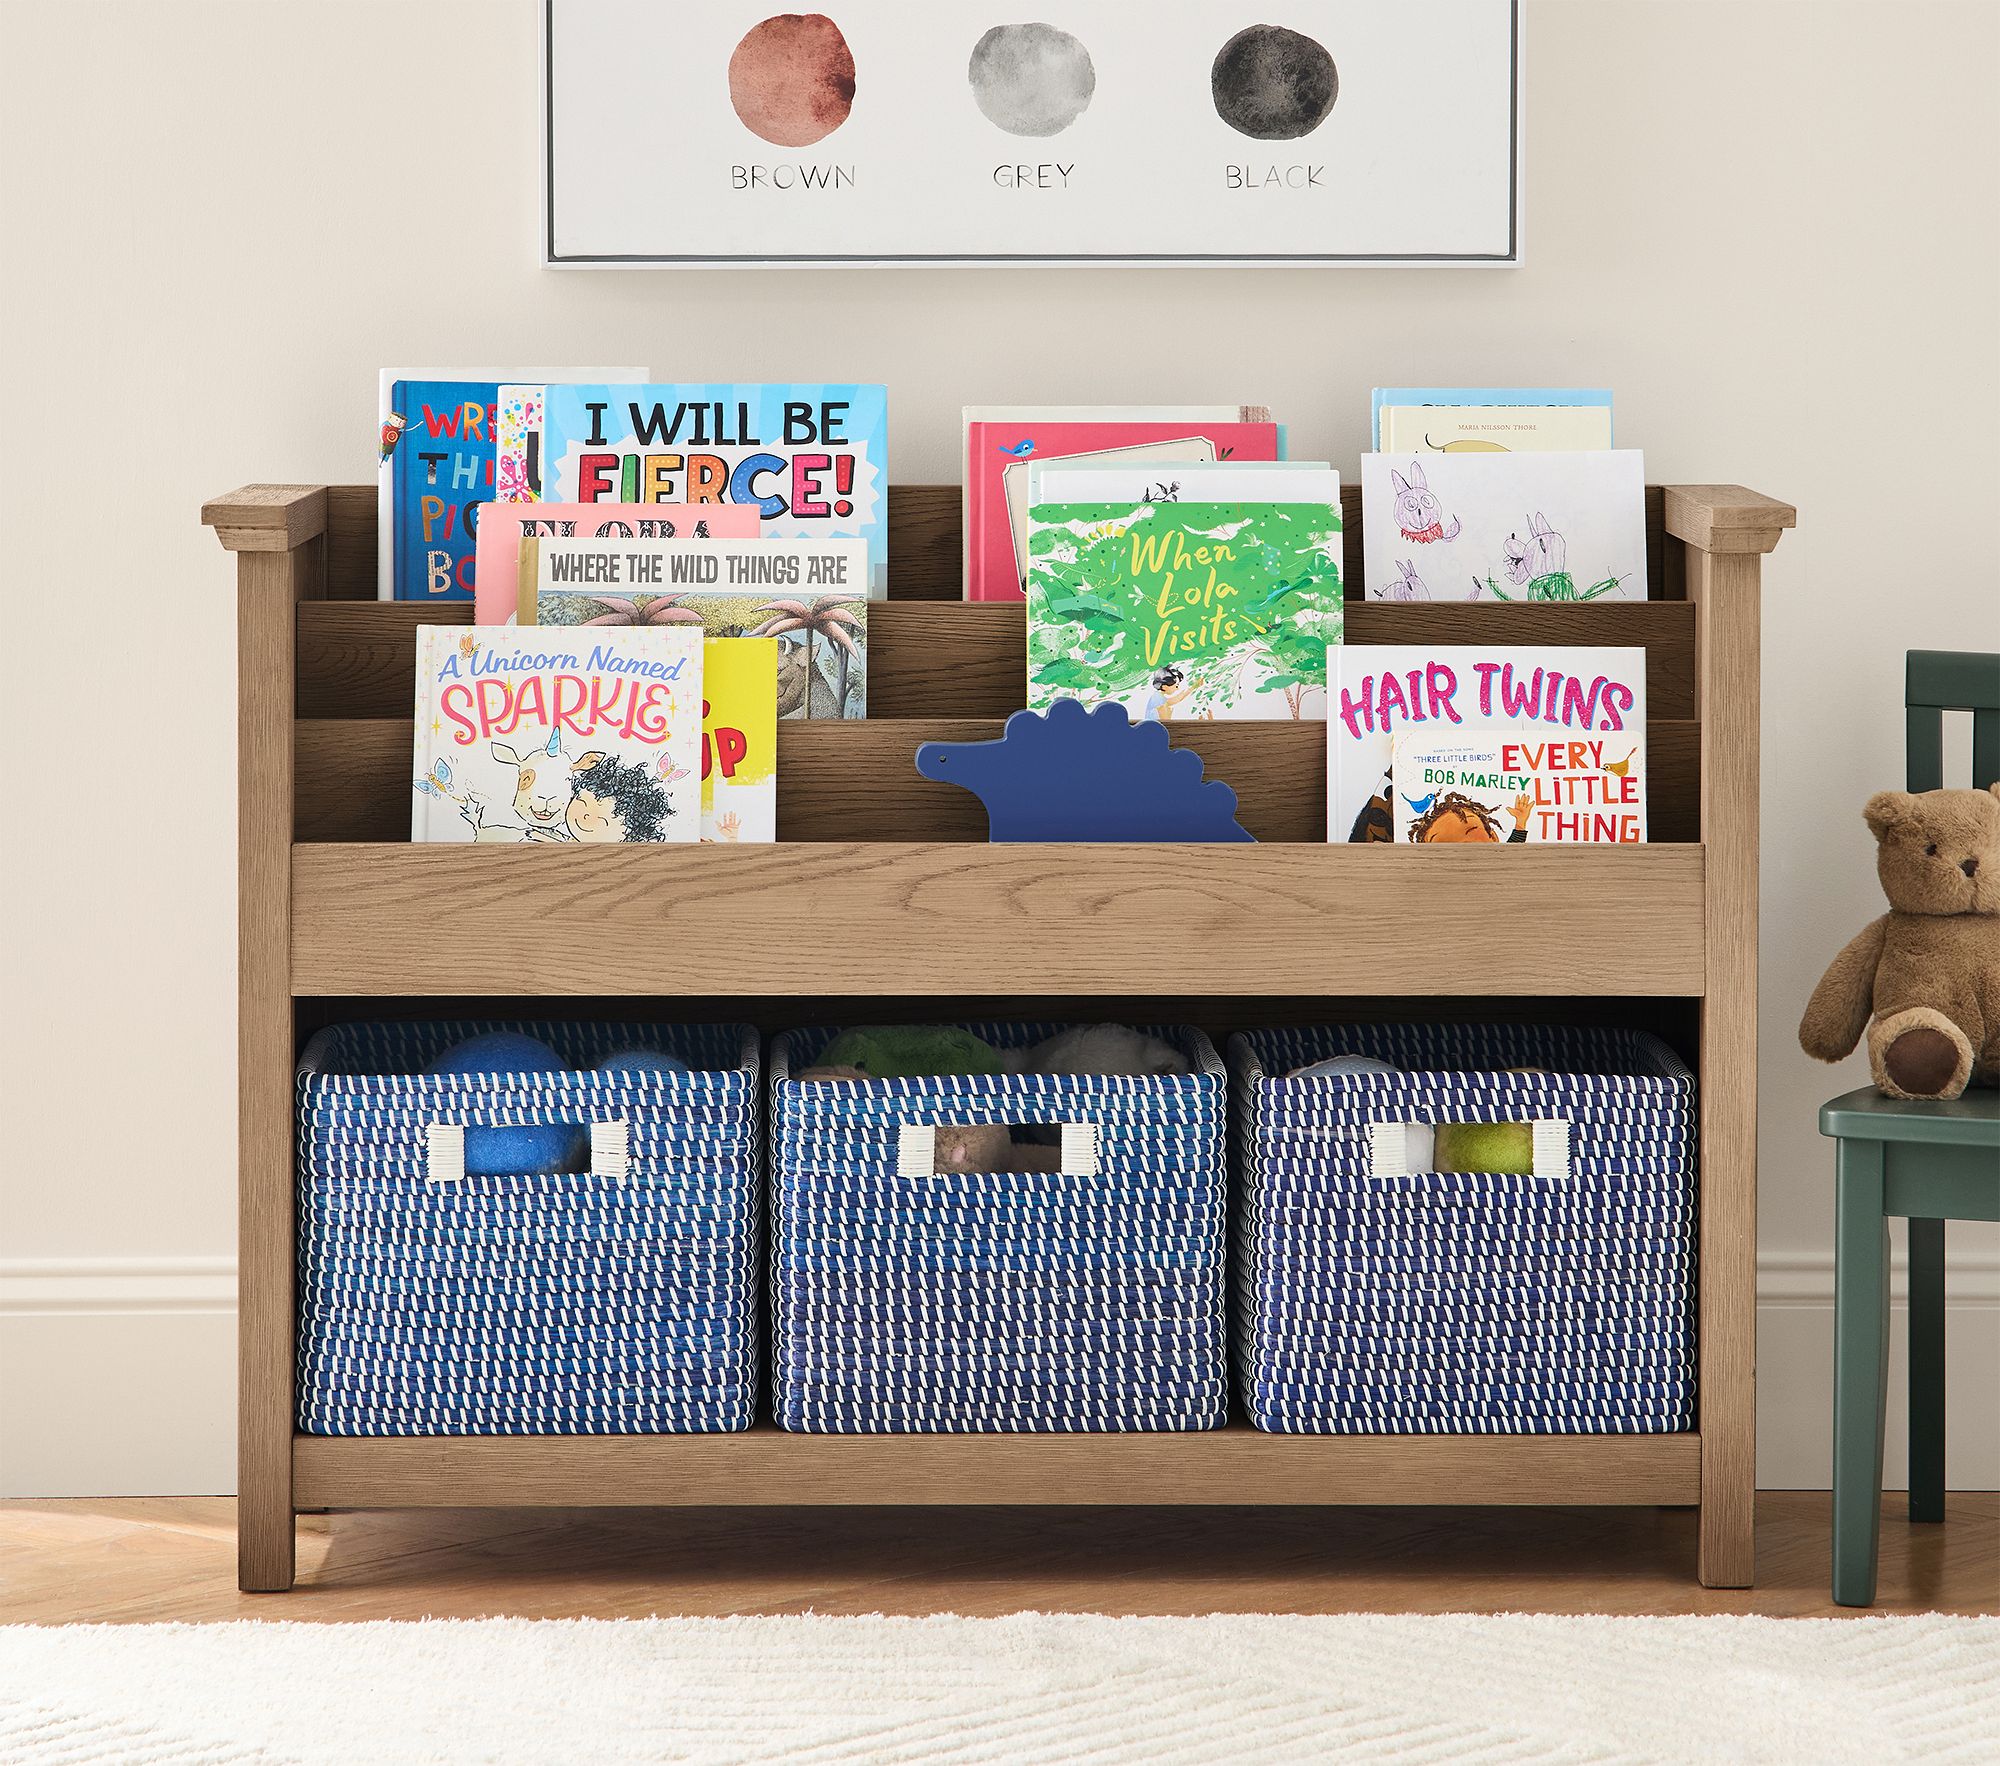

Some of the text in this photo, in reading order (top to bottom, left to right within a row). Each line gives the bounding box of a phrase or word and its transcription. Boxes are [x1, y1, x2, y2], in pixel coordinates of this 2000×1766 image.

[731, 164, 855, 190] BROWN
[993, 164, 1075, 190] GREY
[1225, 164, 1327, 190] BLACK
[585, 402, 849, 446] I WILL BE
[578, 453, 856, 520] FIERCE!
[550, 553, 848, 585] WHERE THE WILD THINGS ARE
[1131, 531, 1236, 577] When
[1156, 566, 1239, 619] Lola
[1140, 613, 1237, 667] Visits
[437, 645, 687, 684] A Unicorn Named
[440, 674, 673, 746] SPARKLE
[1339, 660, 1635, 741] HAIR TWINS
[1443, 754, 1467, 763] LITTLE
[1502, 741, 1603, 772] EVERY
[1424, 768, 1531, 791] BOB MARLEY
